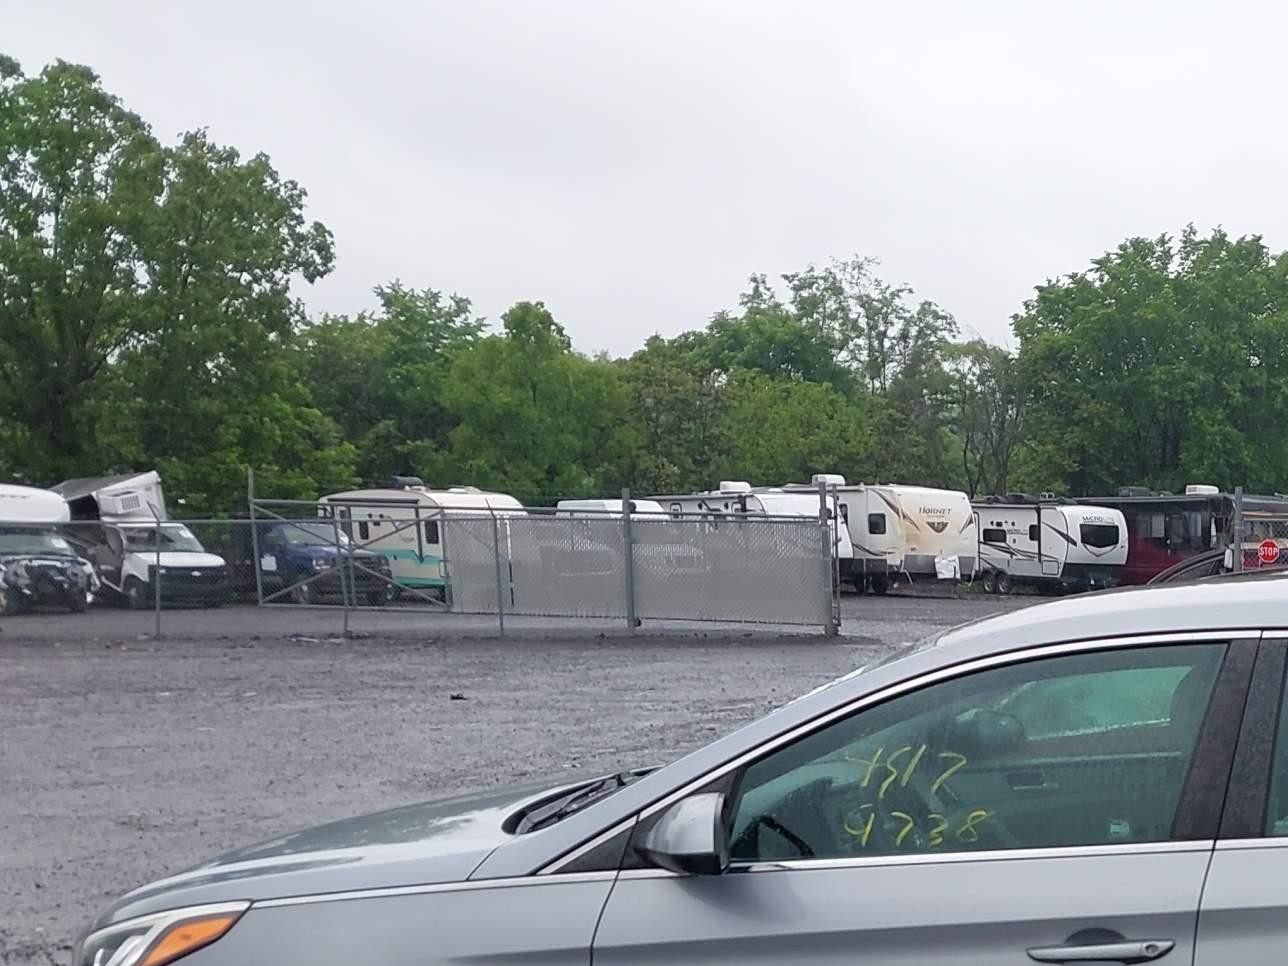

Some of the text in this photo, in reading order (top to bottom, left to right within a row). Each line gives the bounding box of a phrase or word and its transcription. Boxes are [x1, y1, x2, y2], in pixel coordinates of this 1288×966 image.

[919, 505, 952, 515] HORNET
[1260, 546, 1278, 557] STOP
[844, 803, 995, 847] 9738
